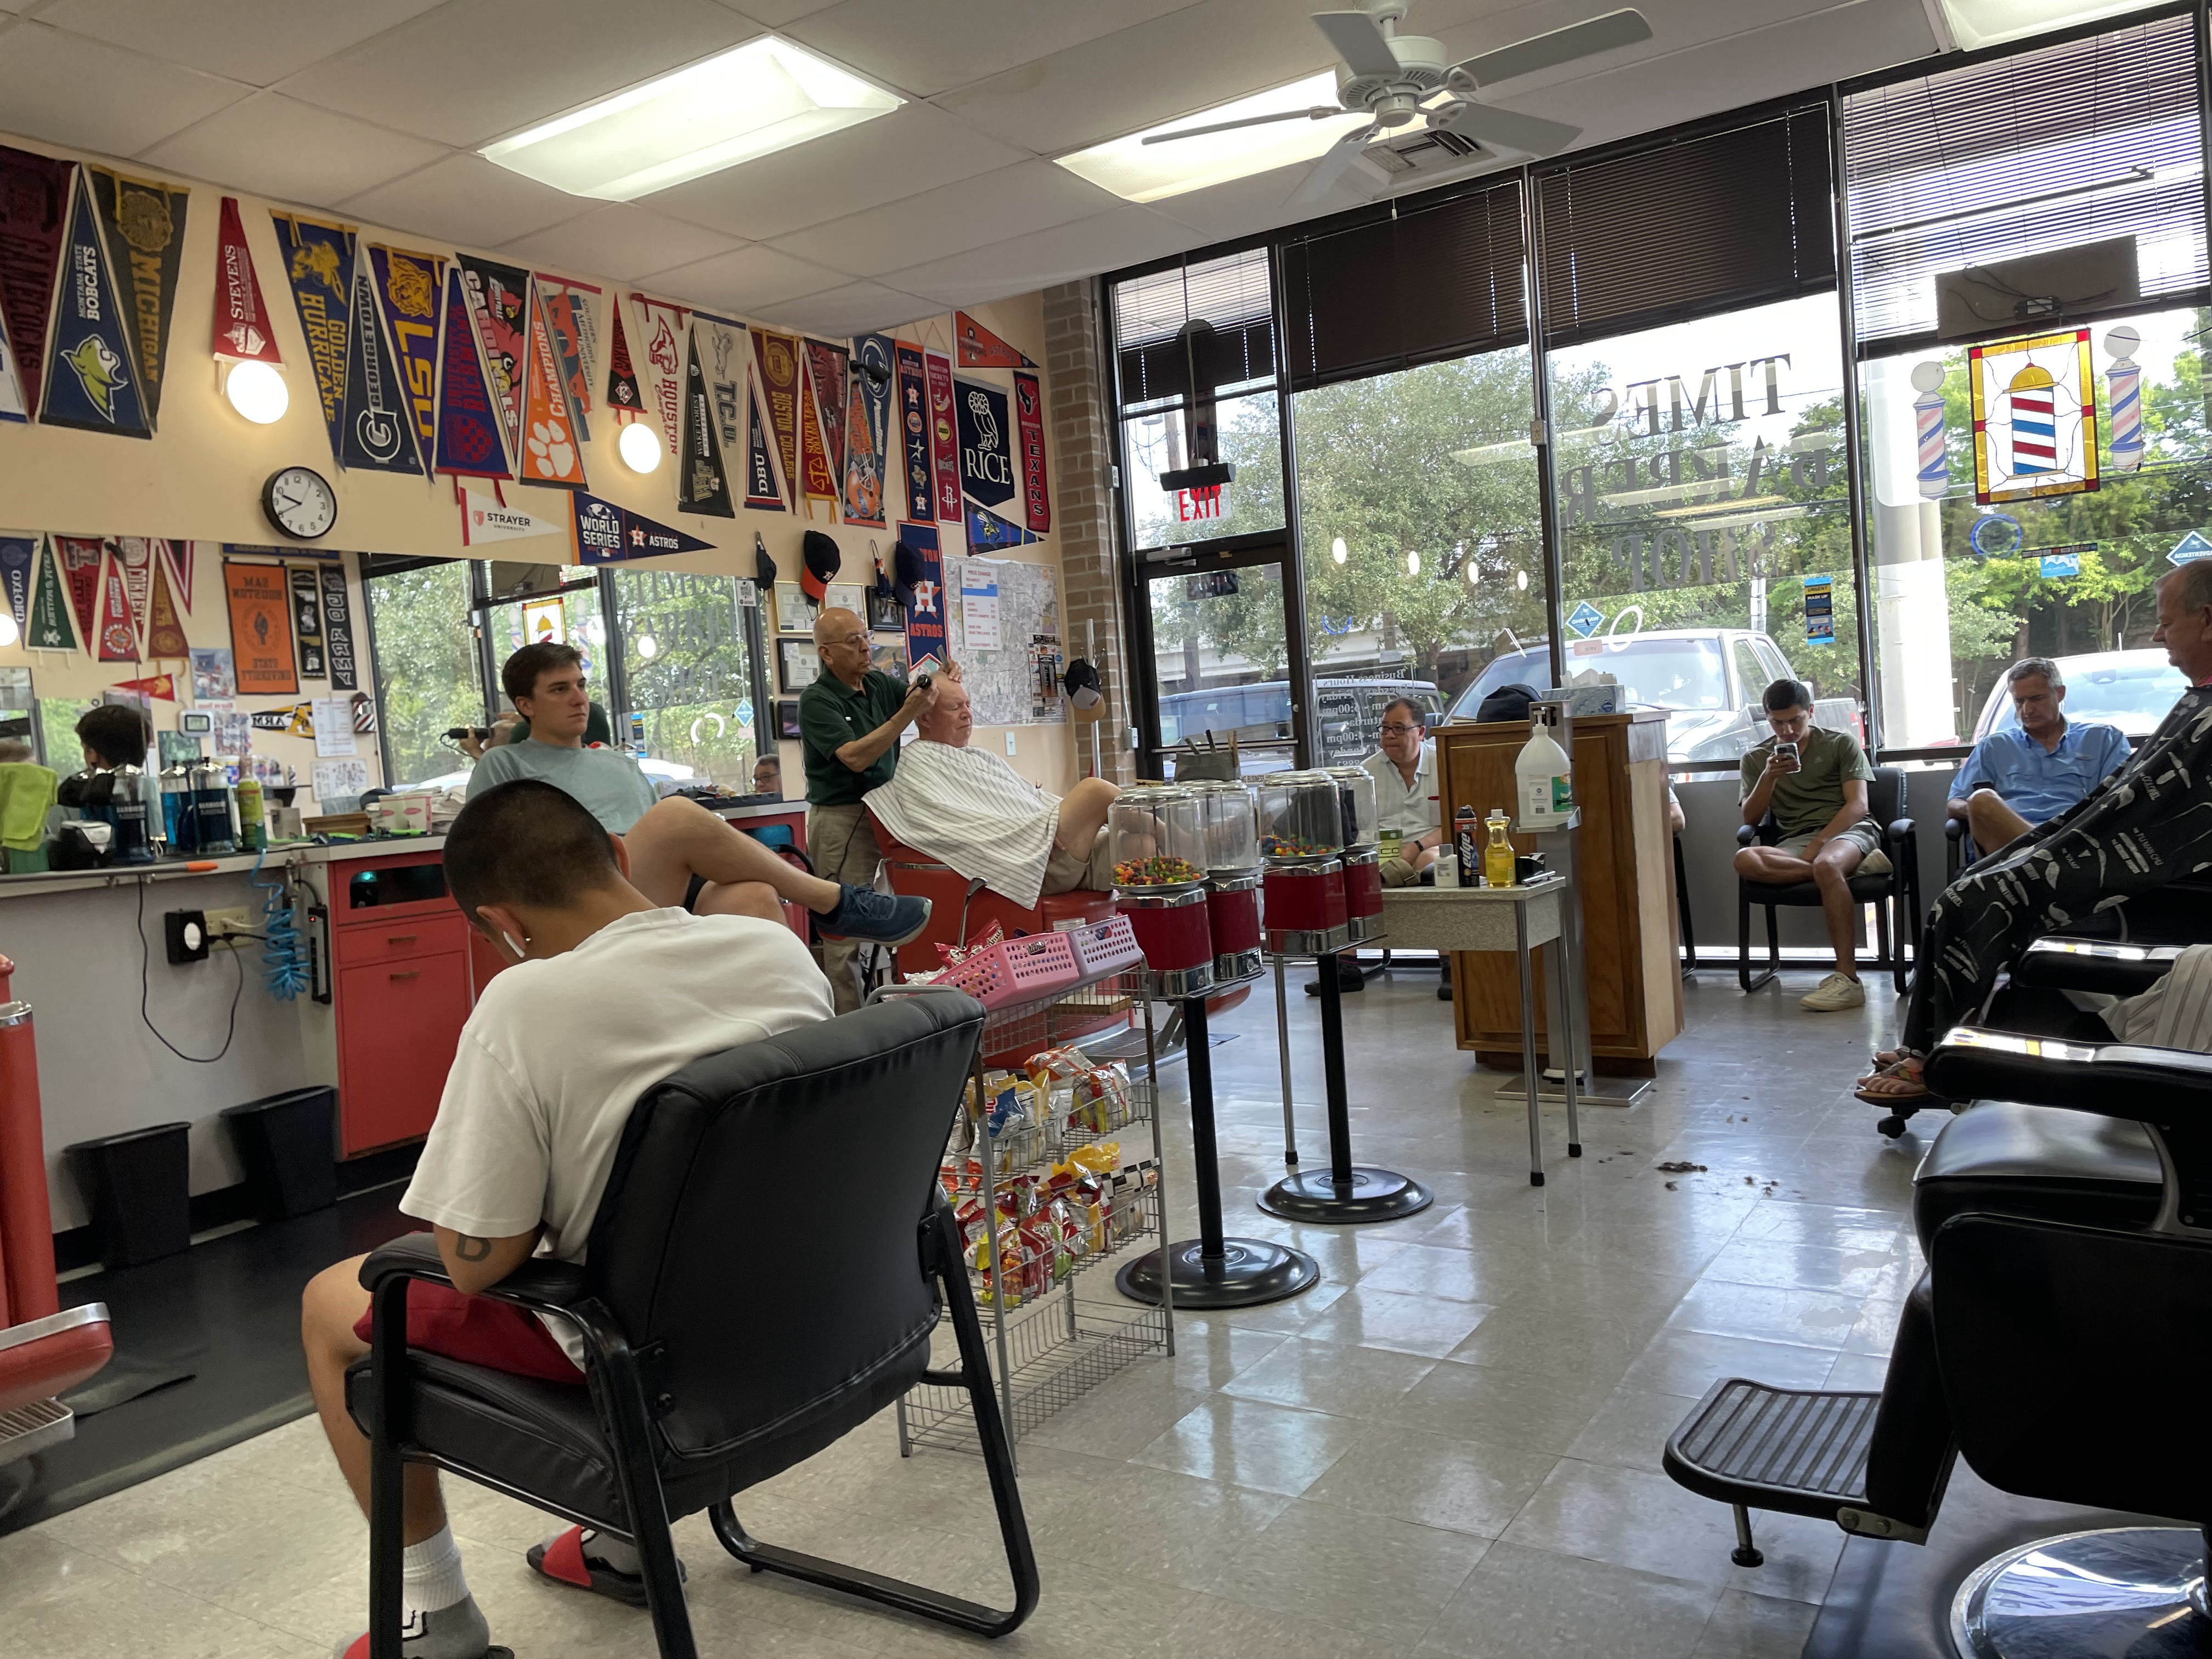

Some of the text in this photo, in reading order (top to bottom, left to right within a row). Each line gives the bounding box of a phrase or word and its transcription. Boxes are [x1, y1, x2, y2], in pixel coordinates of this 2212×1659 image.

[74, 244, 84, 271] STATE
[83, 246, 100, 321] BOBCATS
[225, 245, 244, 319] STEVENS
[131, 249, 162, 382] MICHIGAN
[357, 275, 382, 407] GEORGETOWN
[577, 313, 595, 363] METHODIST
[582, 297, 596, 343] SOUTHERN
[298, 291, 335, 421] HURRICANE
[329, 319, 346, 400] GOLDEN
[456, 304, 486, 411] RICHMOND
[464, 270, 518, 428] CARDINALS
[533, 321, 565, 417] CHAMPIONS
[394, 320, 433, 437] LSU
[662, 378, 678, 455] HOUSTON
[692, 393, 703, 455] WAKE FOREST
[770, 391, 795, 479] BOSTON COLLEGE
[805, 422, 816, 454] SOUTH
[756, 453, 768, 493] DBU
[964, 448, 1010, 485] RICE
[1027, 430, 1043, 515] TEXANS
[488, 512, 531, 527] STRAYER
[580, 515, 619, 535] WORLD
[1179, 484, 1221, 522] EXIT
[583, 532, 620, 549] SERIES
[649, 535, 679, 549] ASTROS
[910, 623, 943, 638] ASTROS
[1459, 832, 1474, 868] edge
[1946, 887, 1964, 907] OLONEL
